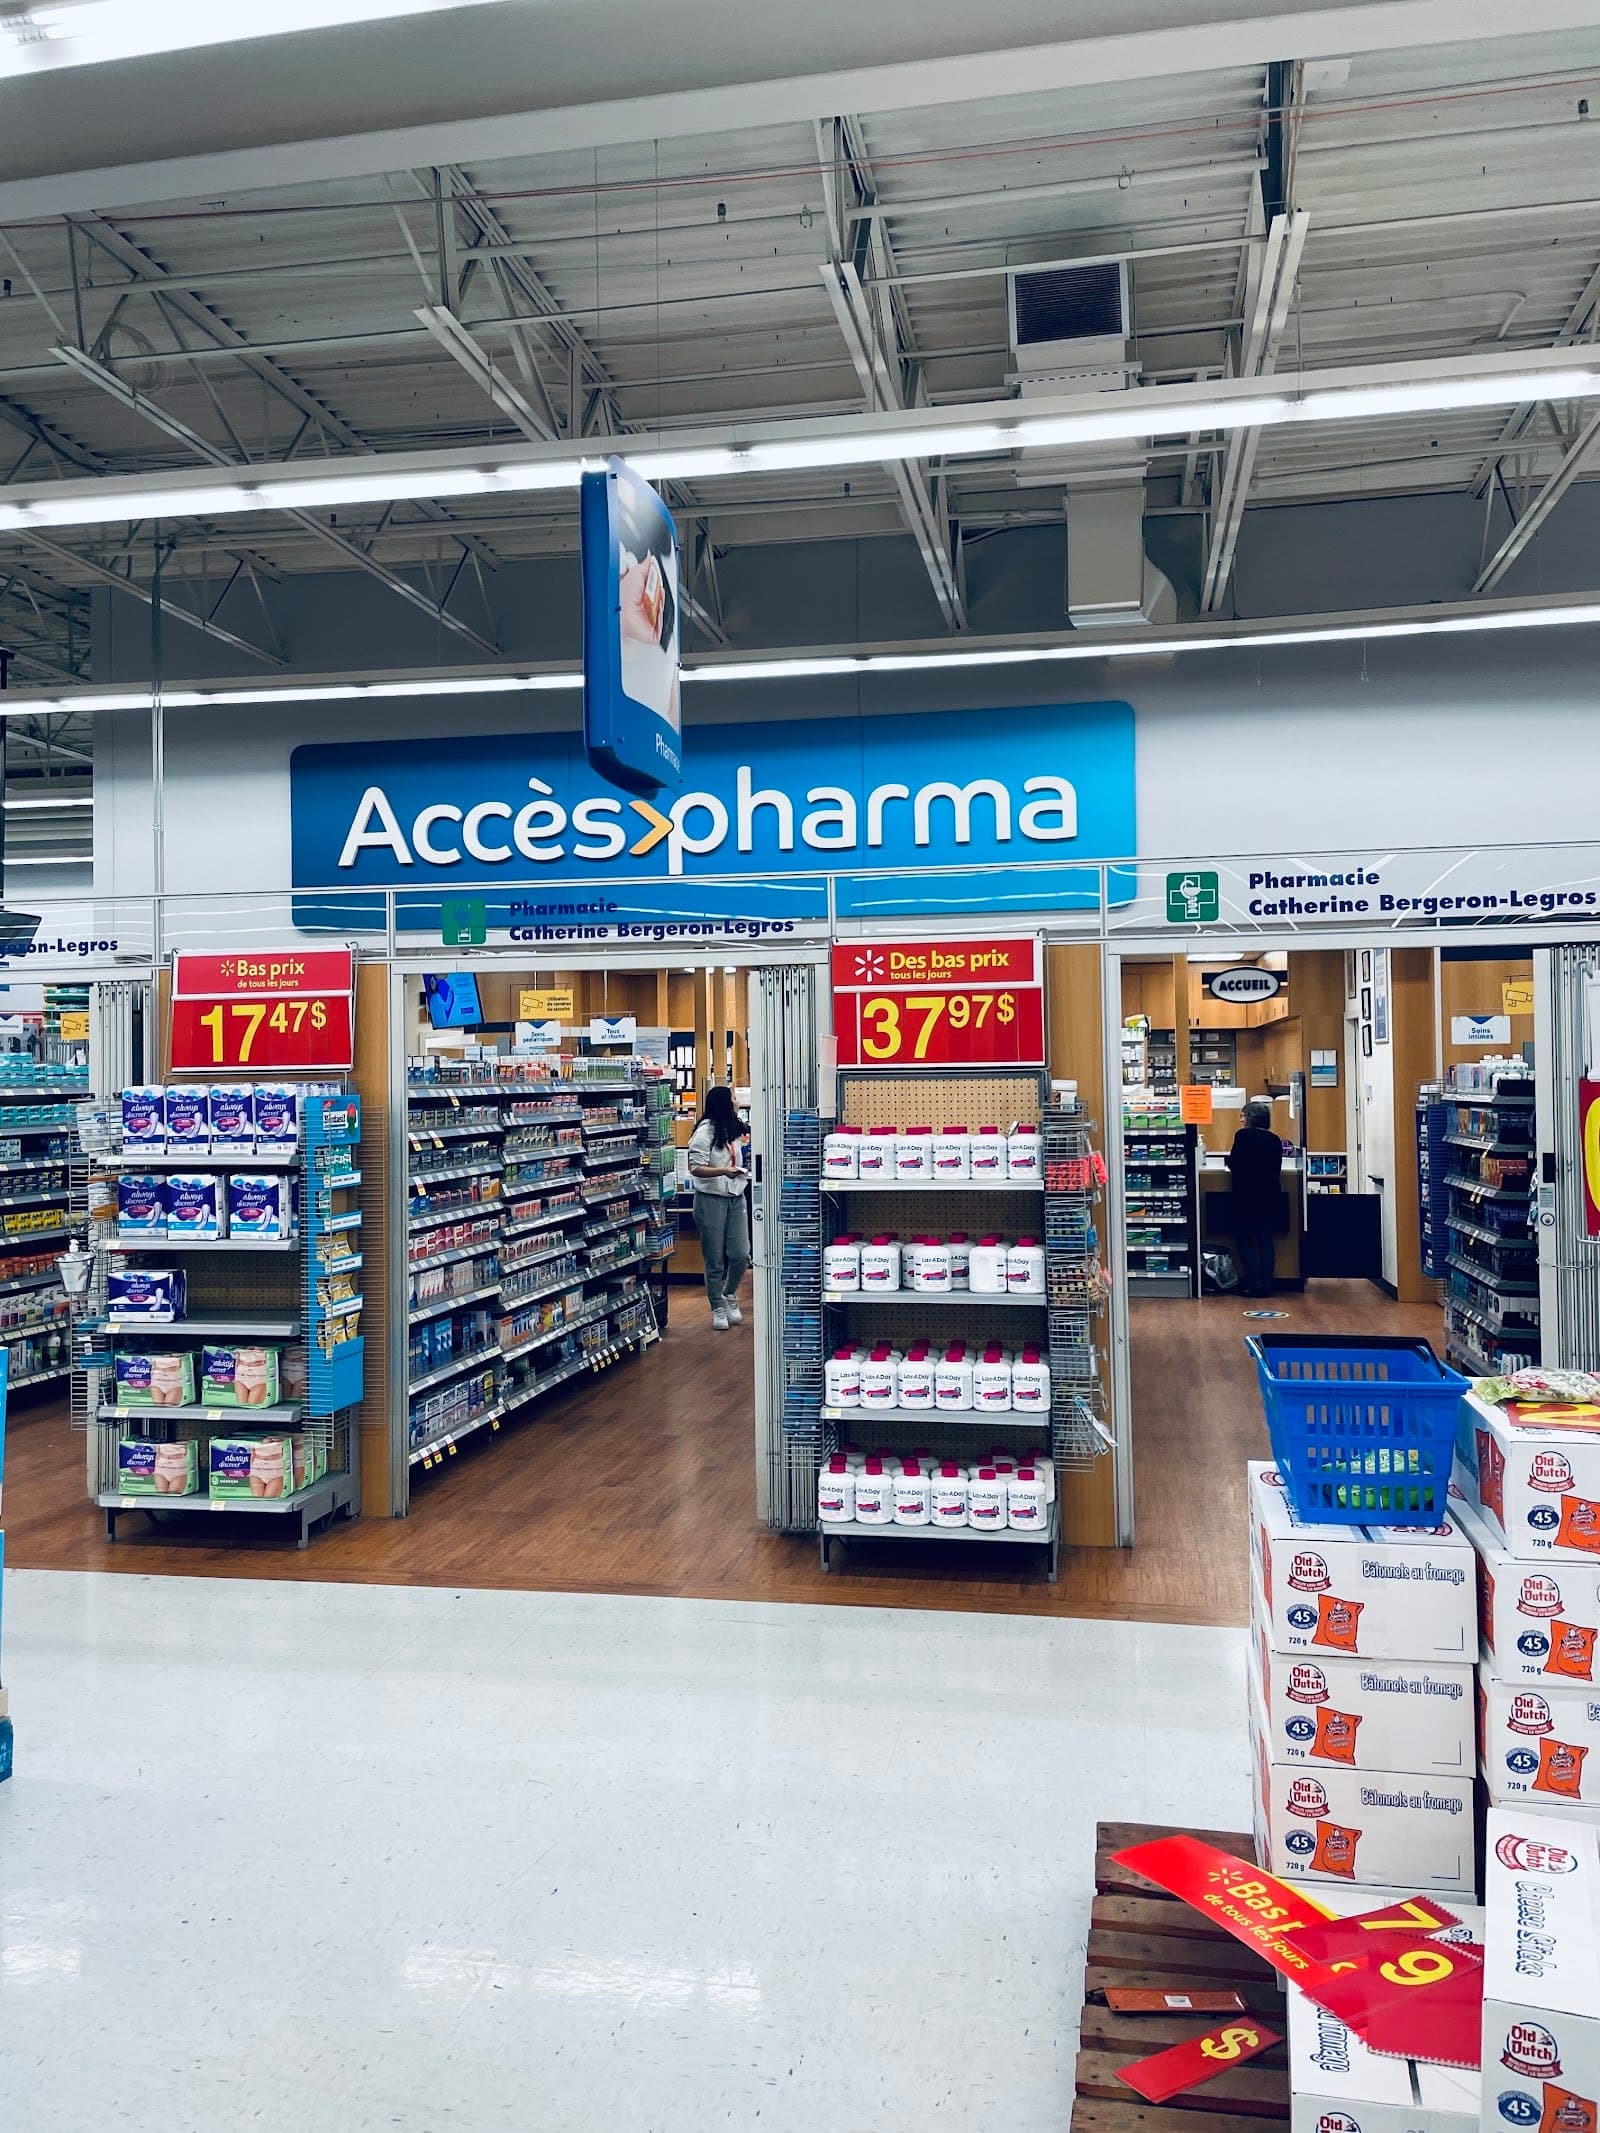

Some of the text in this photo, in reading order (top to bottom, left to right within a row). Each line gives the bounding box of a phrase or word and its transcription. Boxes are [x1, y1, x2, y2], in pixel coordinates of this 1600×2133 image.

[337, 765, 1077, 875] Accès pharma
[1248, 867, 1380, 890] Pharmacie
[510, 898, 618, 917] Pharmacie
[1248, 889, 1597, 916] Catherine Bergeron-Legros
[509, 918, 794, 941] Catherine Bergeron-Legros
[890, 949, 1009, 971] Des bas prix
[236, 959, 305, 980] Bas prix
[890, 970, 952, 981] tous les jours
[237, 978, 299, 989] de tous les jours
[1219, 978, 1271, 992] ACCUEIL
[1471, 1026, 1491, 1034] Soins
[220, 1102, 244, 1112] always
[264, 1102, 287, 1112] always
[131, 1190, 156, 1201] always
[180, 1192, 204, 1202] always
[242, 1192, 267, 1203] always
[224, 1454, 249, 1464] always
[1535, 1455, 1554, 1466] Old
[1535, 1466, 1567, 1478] Dutch
[1534, 1512, 1552, 1524] 45
[1547, 1540, 1552, 1548] g
[1294, 1555, 1312, 1567] Old
[1294, 1566, 1324, 1578] Dutch
[1362, 1559, 1465, 1585] Bâtonnets au fromage
[1523, 1578, 1542, 1589] Old
[1524, 1590, 1556, 1601] Dutch
[1293, 1611, 1310, 1623] 45
[1302, 1638, 1307, 1646] g
[1524, 1637, 1542, 1649] 45
[1292, 1667, 1310, 1678] Old
[1536, 1667, 1541, 1675] g
[1293, 1678, 1322, 1690] Dutch
[1360, 1673, 1463, 1700] Bâtonnets au fromage
[1514, 1696, 1533, 1708] Old
[1515, 1708, 1546, 1720] Dutch
[1292, 1723, 1308, 1734] 45
[1300, 1750, 1305, 1758] g
[1513, 1756, 1531, 1768] 45
[1293, 1780, 1311, 1792] Old
[1522, 1784, 1527, 1792] g
[1293, 1791, 1323, 1804] Dutch
[1360, 1787, 1463, 1815] Bâtonnets au fromage
[1292, 1836, 1308, 1848] 45
[1526, 1843, 1545, 1868] Dutch
[1548, 1847, 1568, 1864] Old
[1300, 1863, 1305, 1872] g
[1226, 1880, 1289, 1921] Bas
[1358, 1901, 1444, 1930] 7
[1203, 1893, 1221, 1908] de
[1221, 1903, 1253, 1926] tous
[1249, 1924, 1271, 1942] les
[1267, 1939, 1309, 1970] jours
[1515, 1880, 1557, 1978] Cheese Sticks
[1511, 2025, 1536, 2043] Old
[1200, 2027, 1259, 2060] $
[1511, 2040, 1552, 2061] Dutch
[1507, 2099, 1531, 2117] 45
[1319, 2116, 1343, 2131] Old
